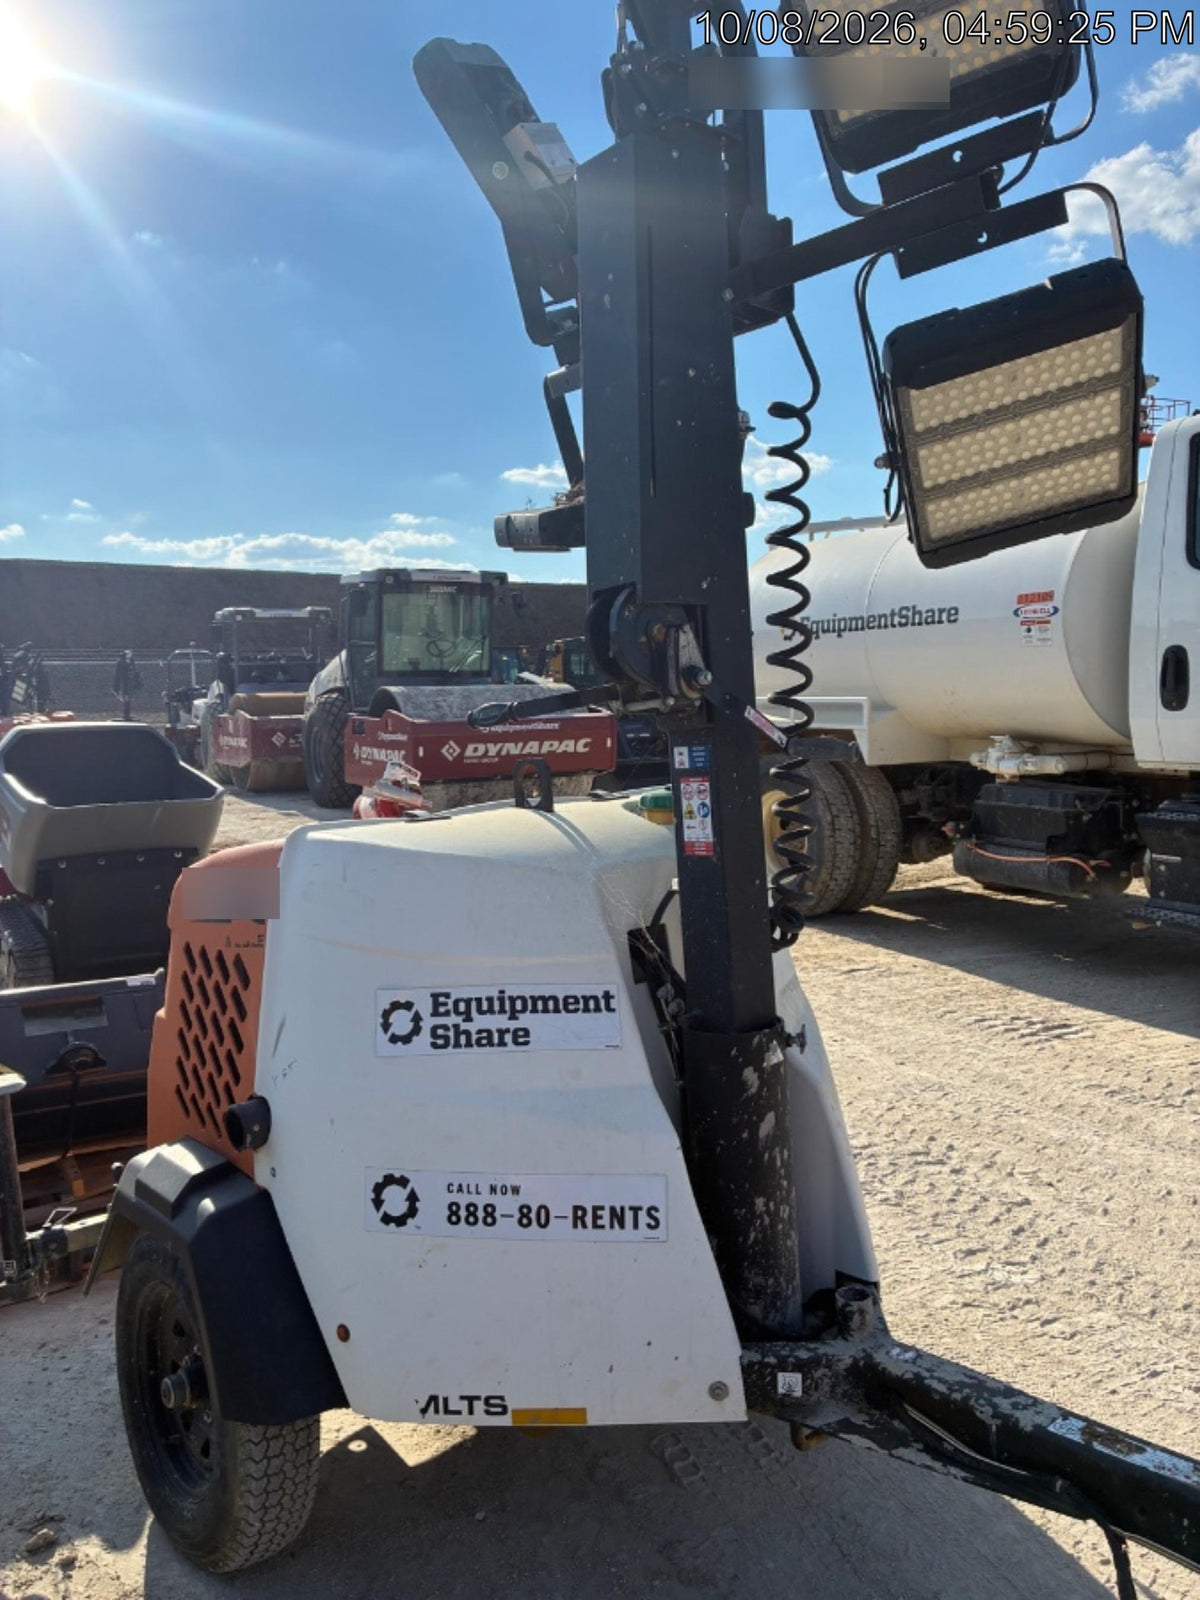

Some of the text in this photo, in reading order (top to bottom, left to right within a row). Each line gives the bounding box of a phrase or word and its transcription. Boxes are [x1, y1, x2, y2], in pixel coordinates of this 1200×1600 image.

[464, 738, 592, 757] DYNAPAC
[430, 990, 616, 1023] Equipment
[430, 1023, 531, 1050] Share
[447, 1182, 521, 1197] CALL NOW
[446, 1201, 661, 1230] 888-80-RENTS
